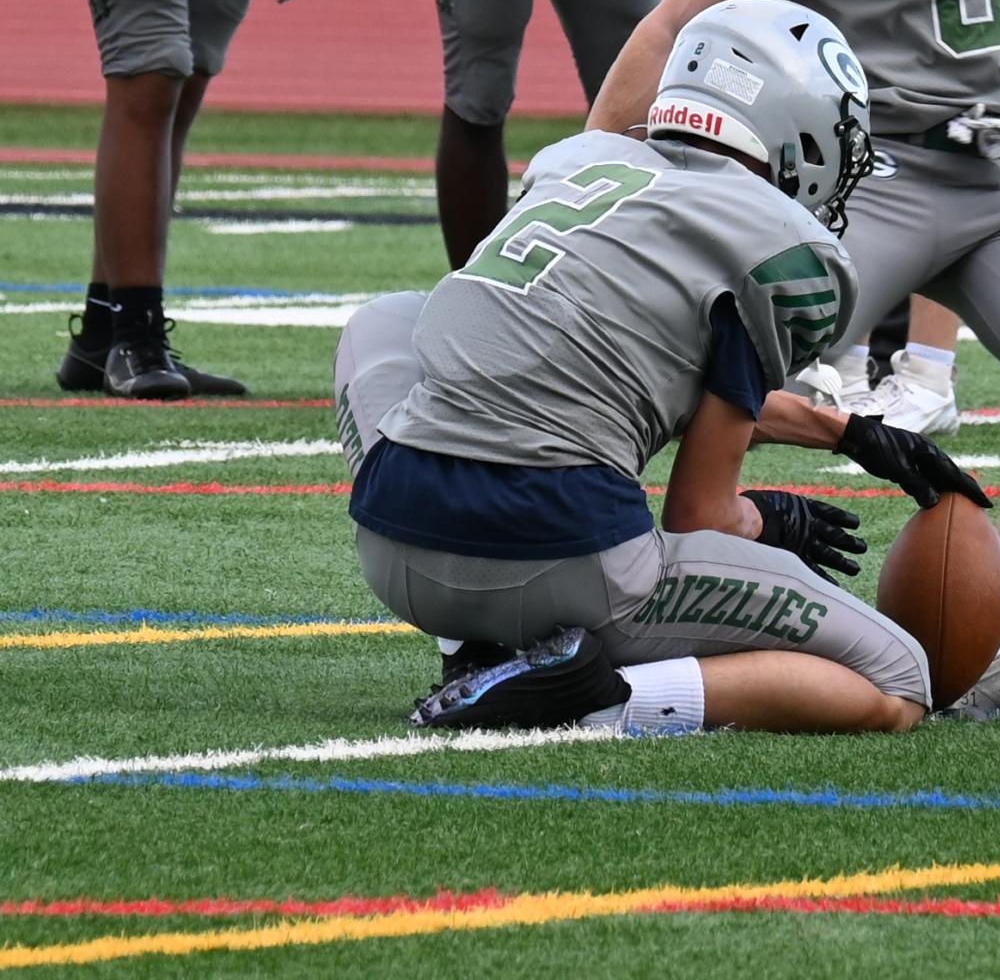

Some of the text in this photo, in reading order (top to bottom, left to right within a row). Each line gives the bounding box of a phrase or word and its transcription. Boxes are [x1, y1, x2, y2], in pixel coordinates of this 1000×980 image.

[817, 37, 869, 108] G
[650, 104, 724, 136] Riddell
[451, 160, 663, 296] 2
[633, 574, 829, 645] GRIZZLIES
